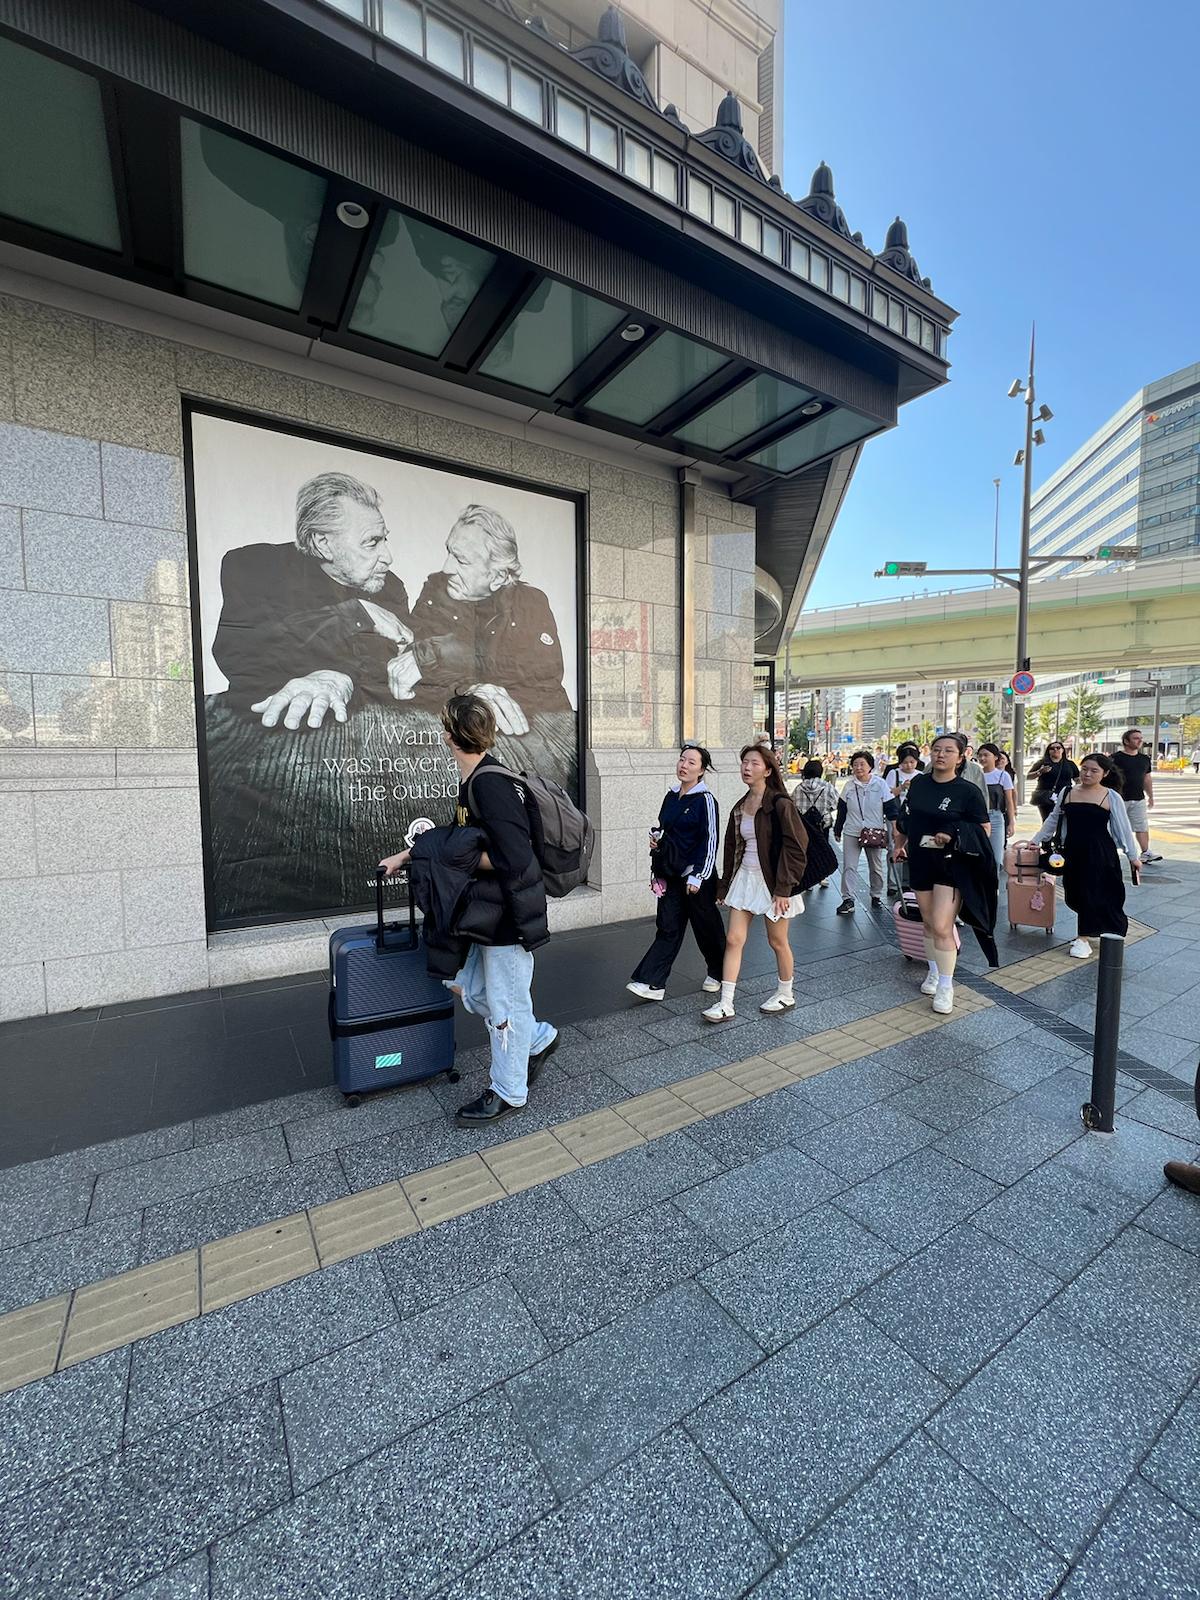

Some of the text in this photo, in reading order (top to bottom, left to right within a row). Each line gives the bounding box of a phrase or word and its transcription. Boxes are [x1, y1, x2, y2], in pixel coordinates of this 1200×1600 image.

[380, 723, 445, 746] Warm
[322, 757, 372, 774] was
[378, 756, 441, 774] never
[348, 776, 461, 802] the outsid
[394, 876, 409, 885] Pac
